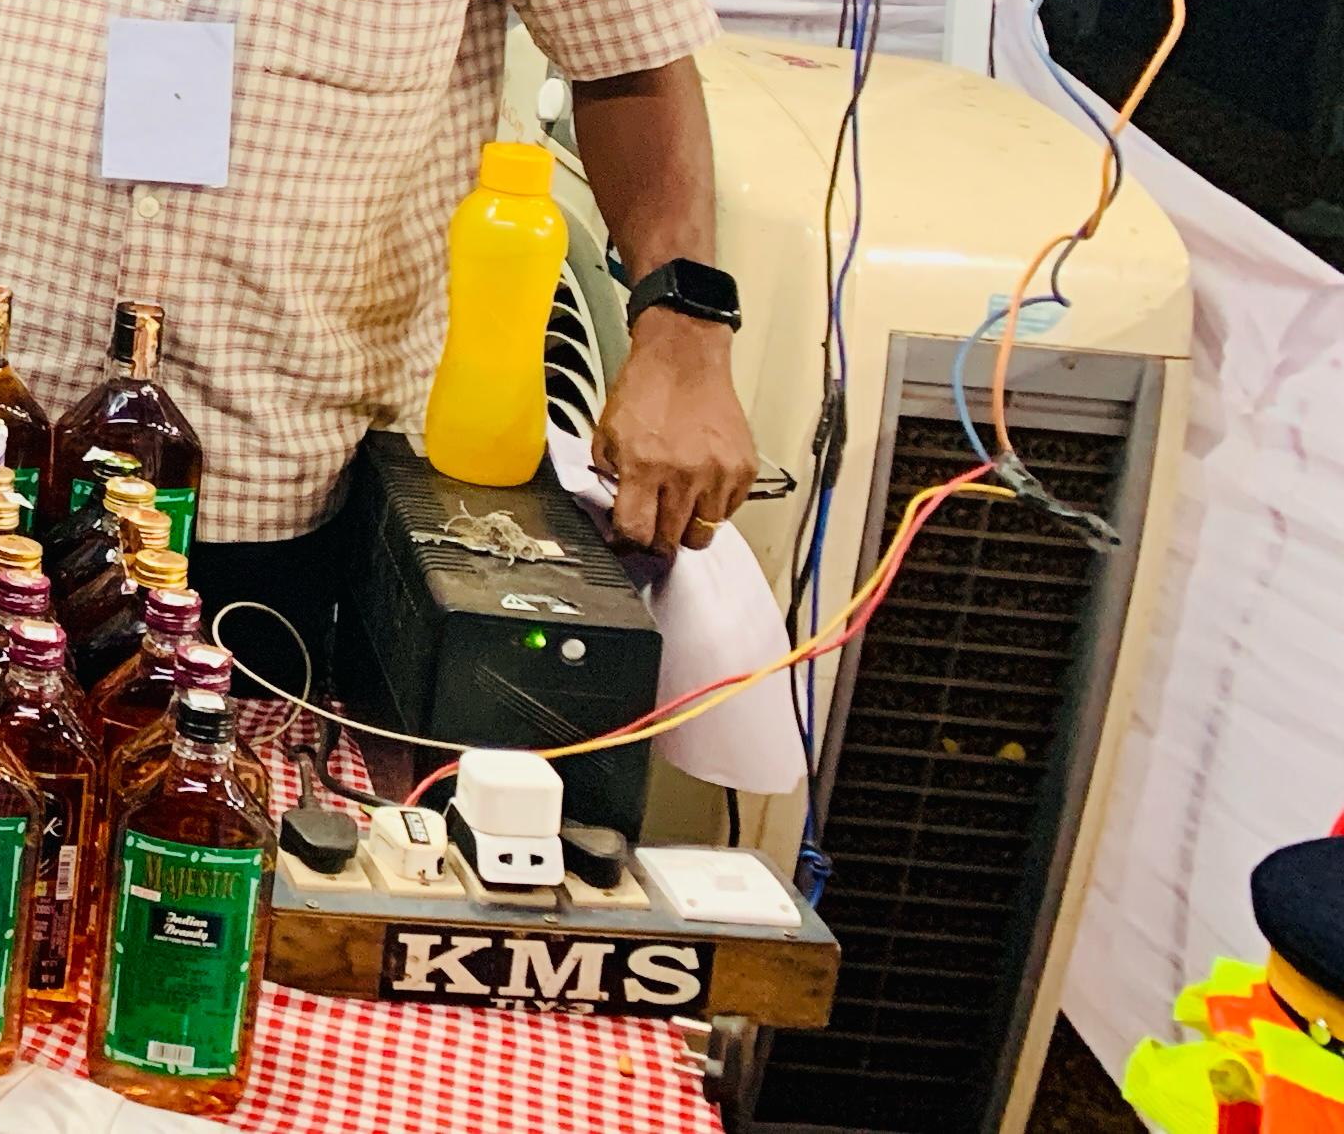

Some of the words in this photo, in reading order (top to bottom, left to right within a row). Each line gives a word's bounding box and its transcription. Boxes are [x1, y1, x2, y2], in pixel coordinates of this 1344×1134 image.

[143, 854, 242, 902] MAJESTIC
[163, 923, 209, 942] Brandy
[165, 911, 209, 928] Indian
[392, 931, 702, 1005] KMS
